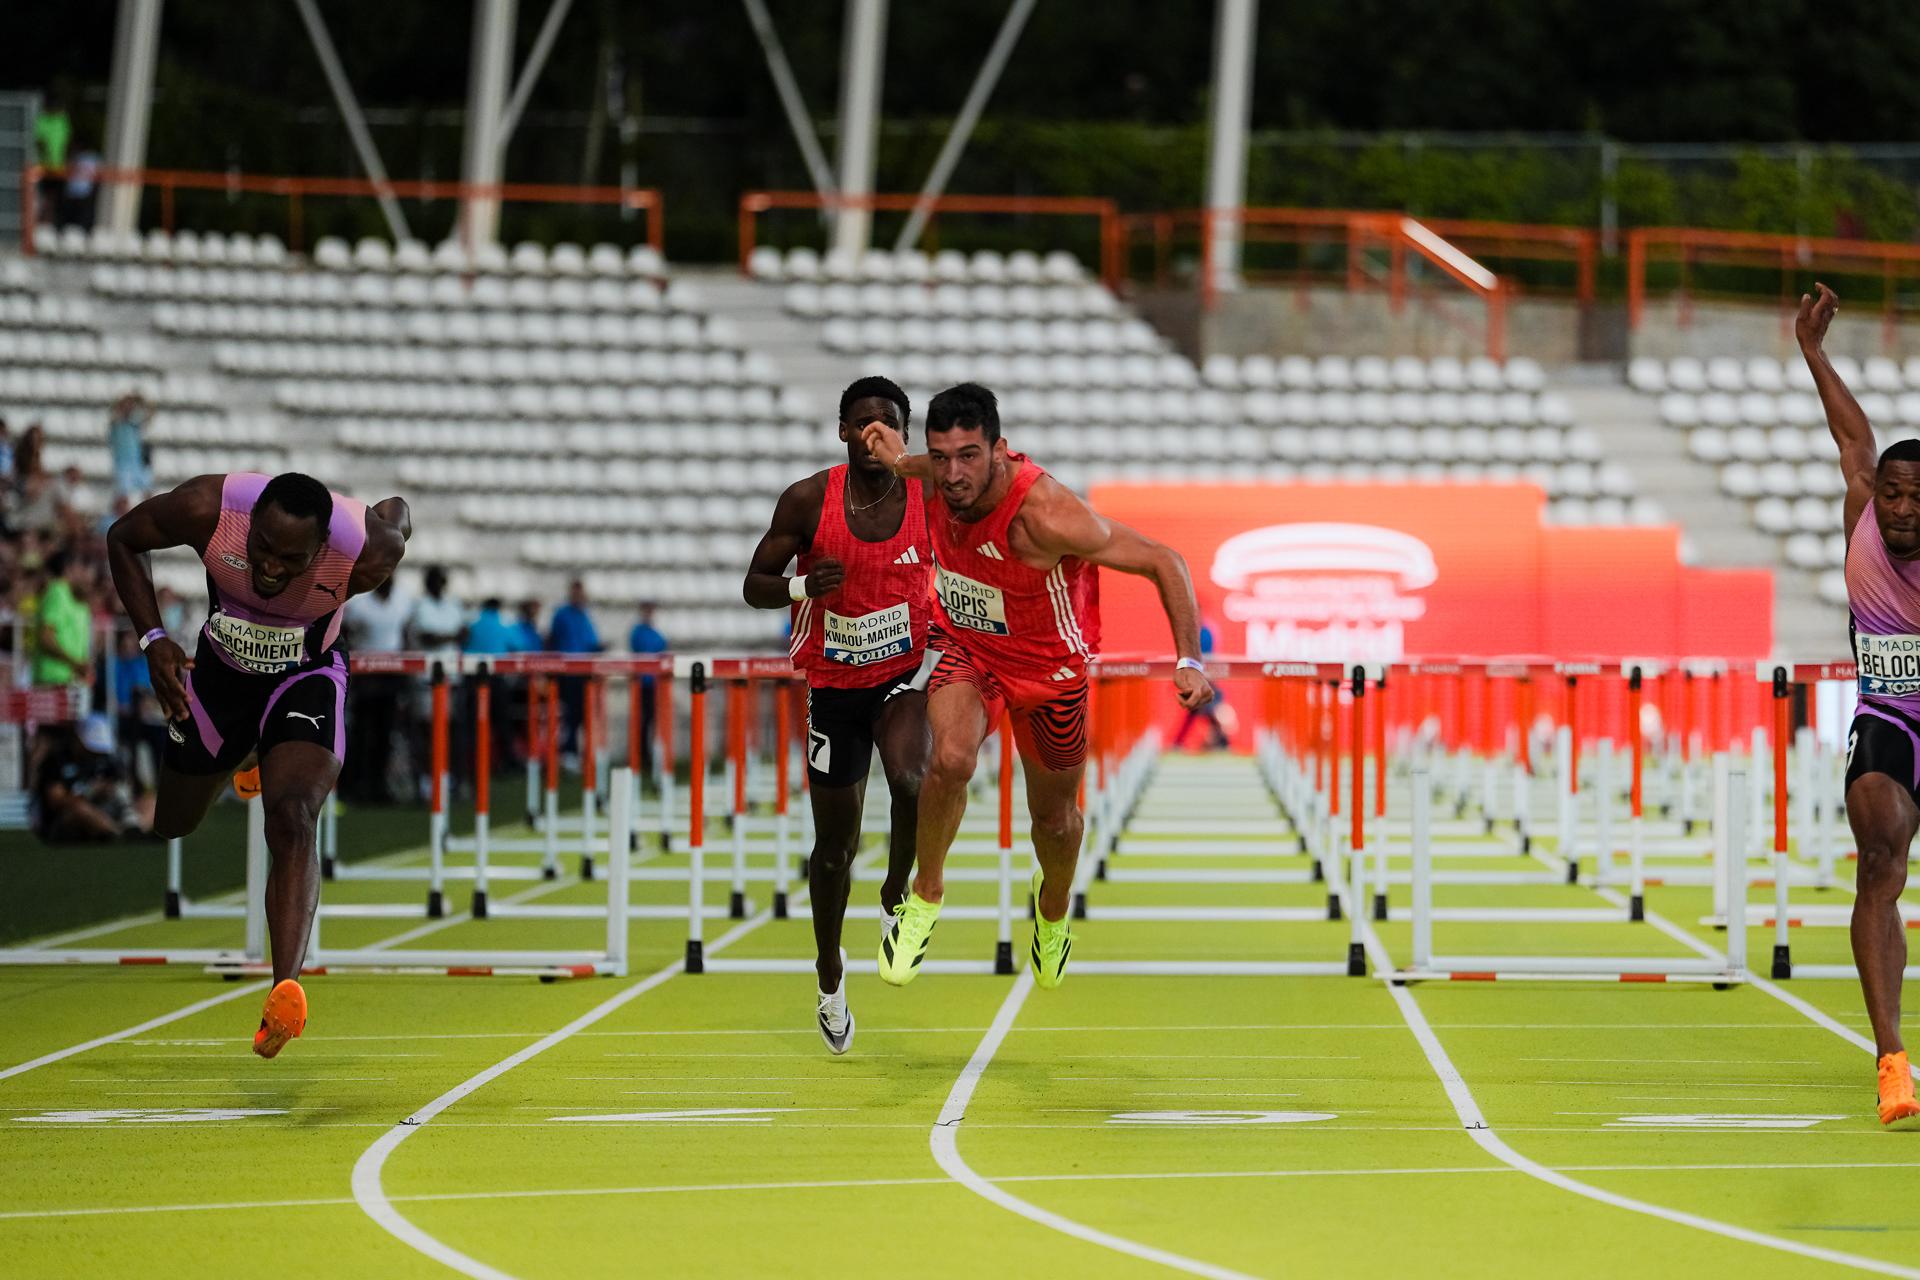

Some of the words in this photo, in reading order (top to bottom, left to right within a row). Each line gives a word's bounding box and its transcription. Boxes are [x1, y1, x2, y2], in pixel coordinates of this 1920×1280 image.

[230, 623, 295, 642] MADRID
[847, 610, 902, 632] MADRID
[825, 621, 909, 647] KWAOU-MATHEY
[850, 642, 903, 665] Joma
[810, 733, 826, 763] 7
